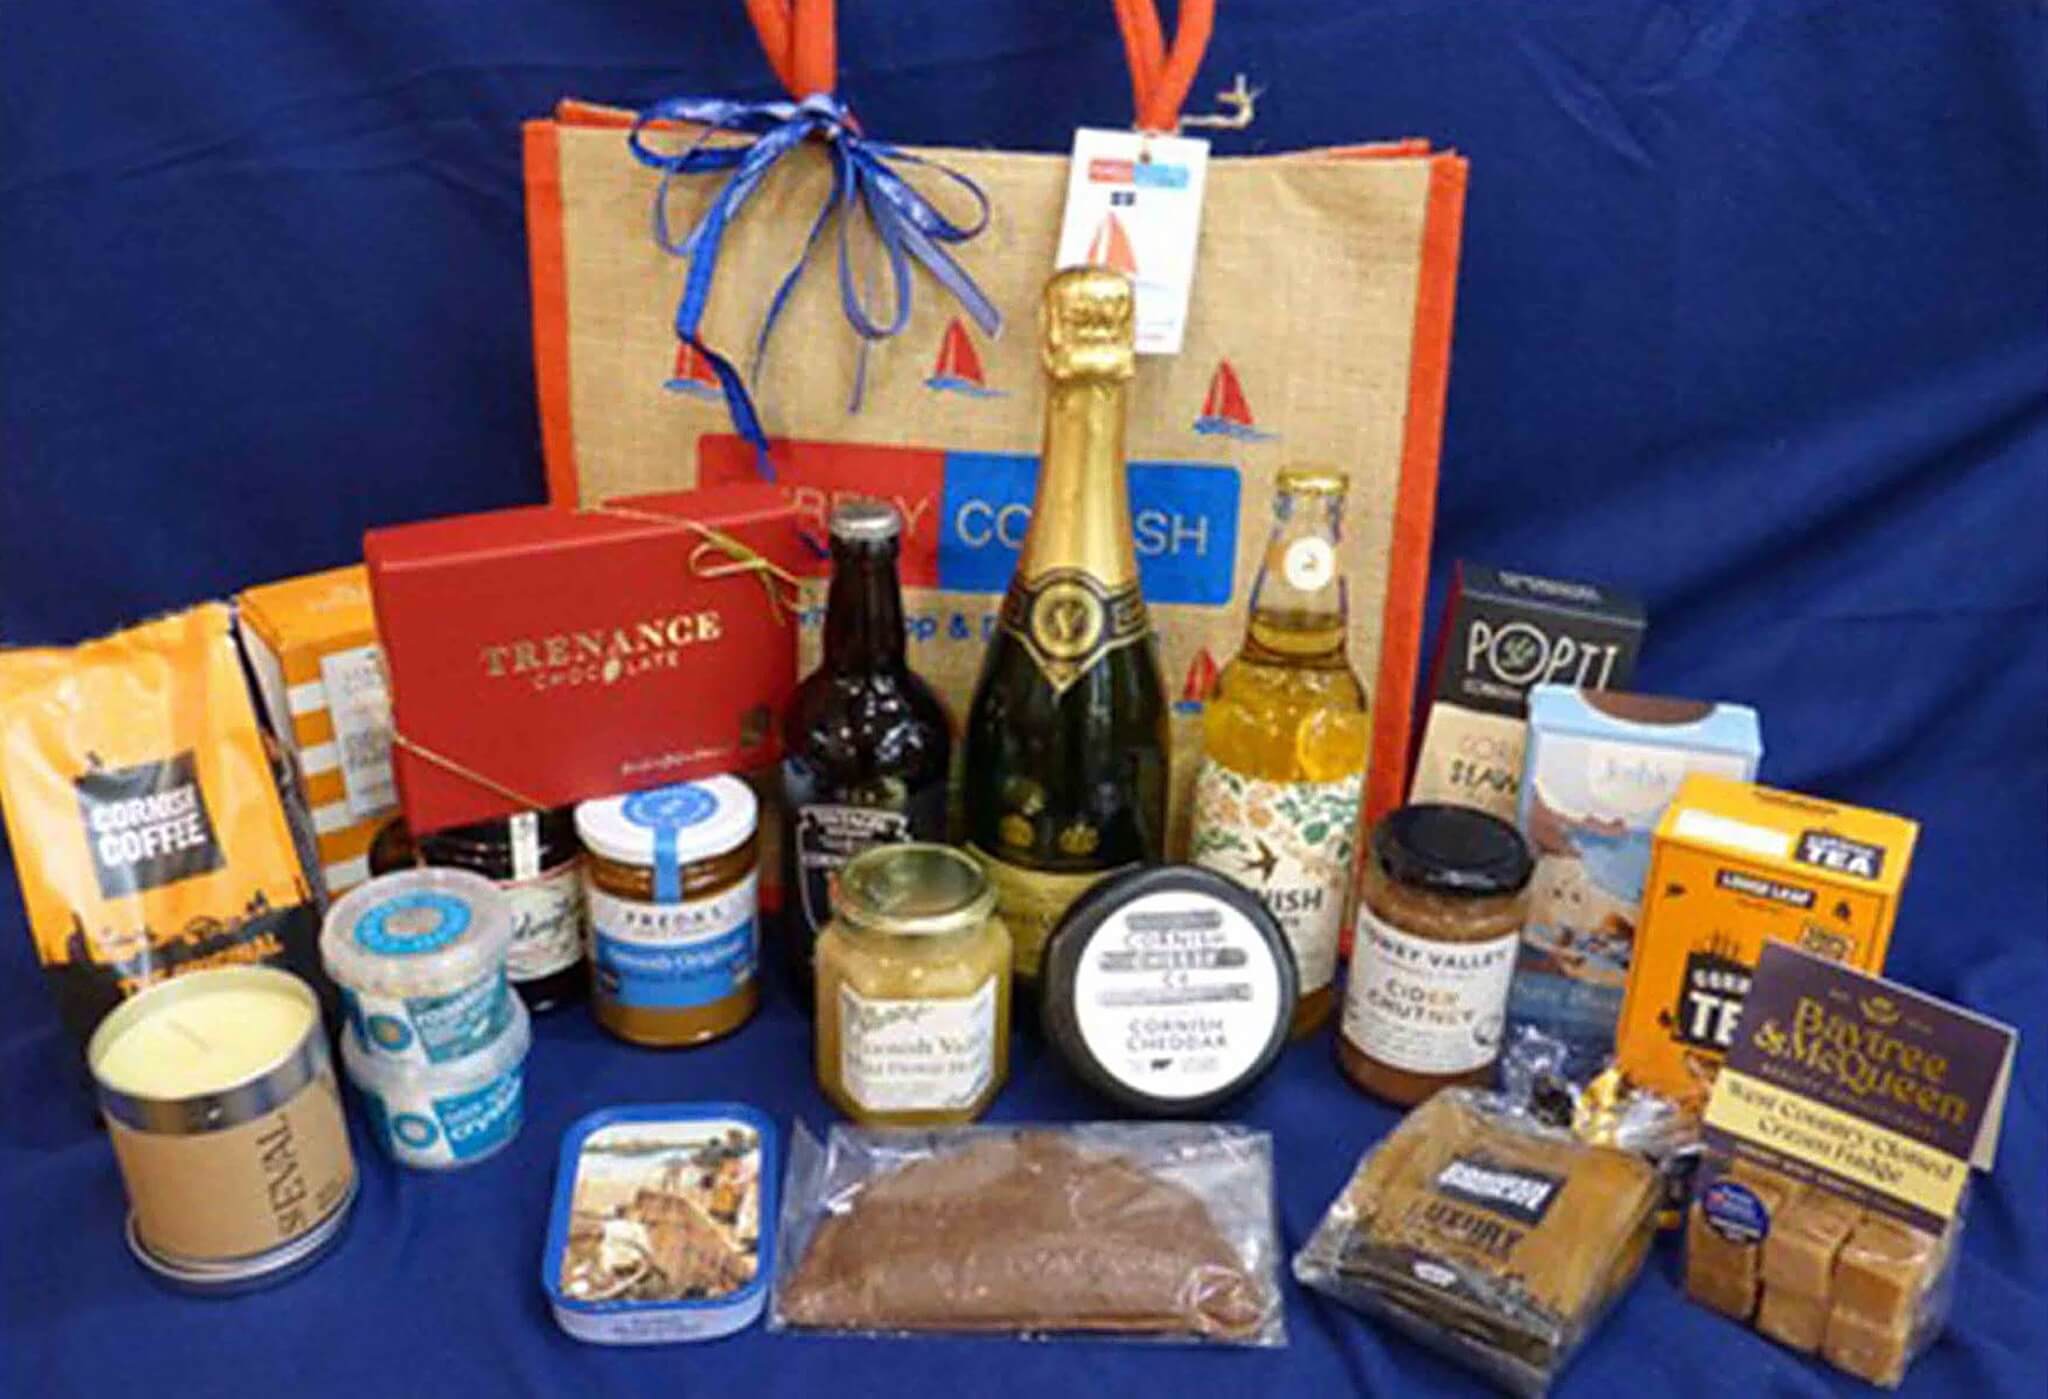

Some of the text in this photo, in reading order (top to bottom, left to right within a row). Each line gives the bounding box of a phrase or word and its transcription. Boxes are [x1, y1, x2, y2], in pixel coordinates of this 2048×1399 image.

[956, 498, 1208, 556] COSH
[481, 609, 722, 678] TRENANCE
[1466, 618, 1619, 690] POPTI
[91, 784, 196, 832] CORNISH
[100, 813, 207, 867] COFFEE
[1806, 845, 1874, 878] TEA
[1428, 948, 1509, 969] VALLEY
[1367, 988, 1474, 1025] CHUTNEY
[1385, 977, 1460, 1003] CIDER
[1128, 1018, 1225, 1035] CORNISH
[1688, 990, 1744, 1047] TE
[1126, 1034, 1227, 1051] CHEDDAR
